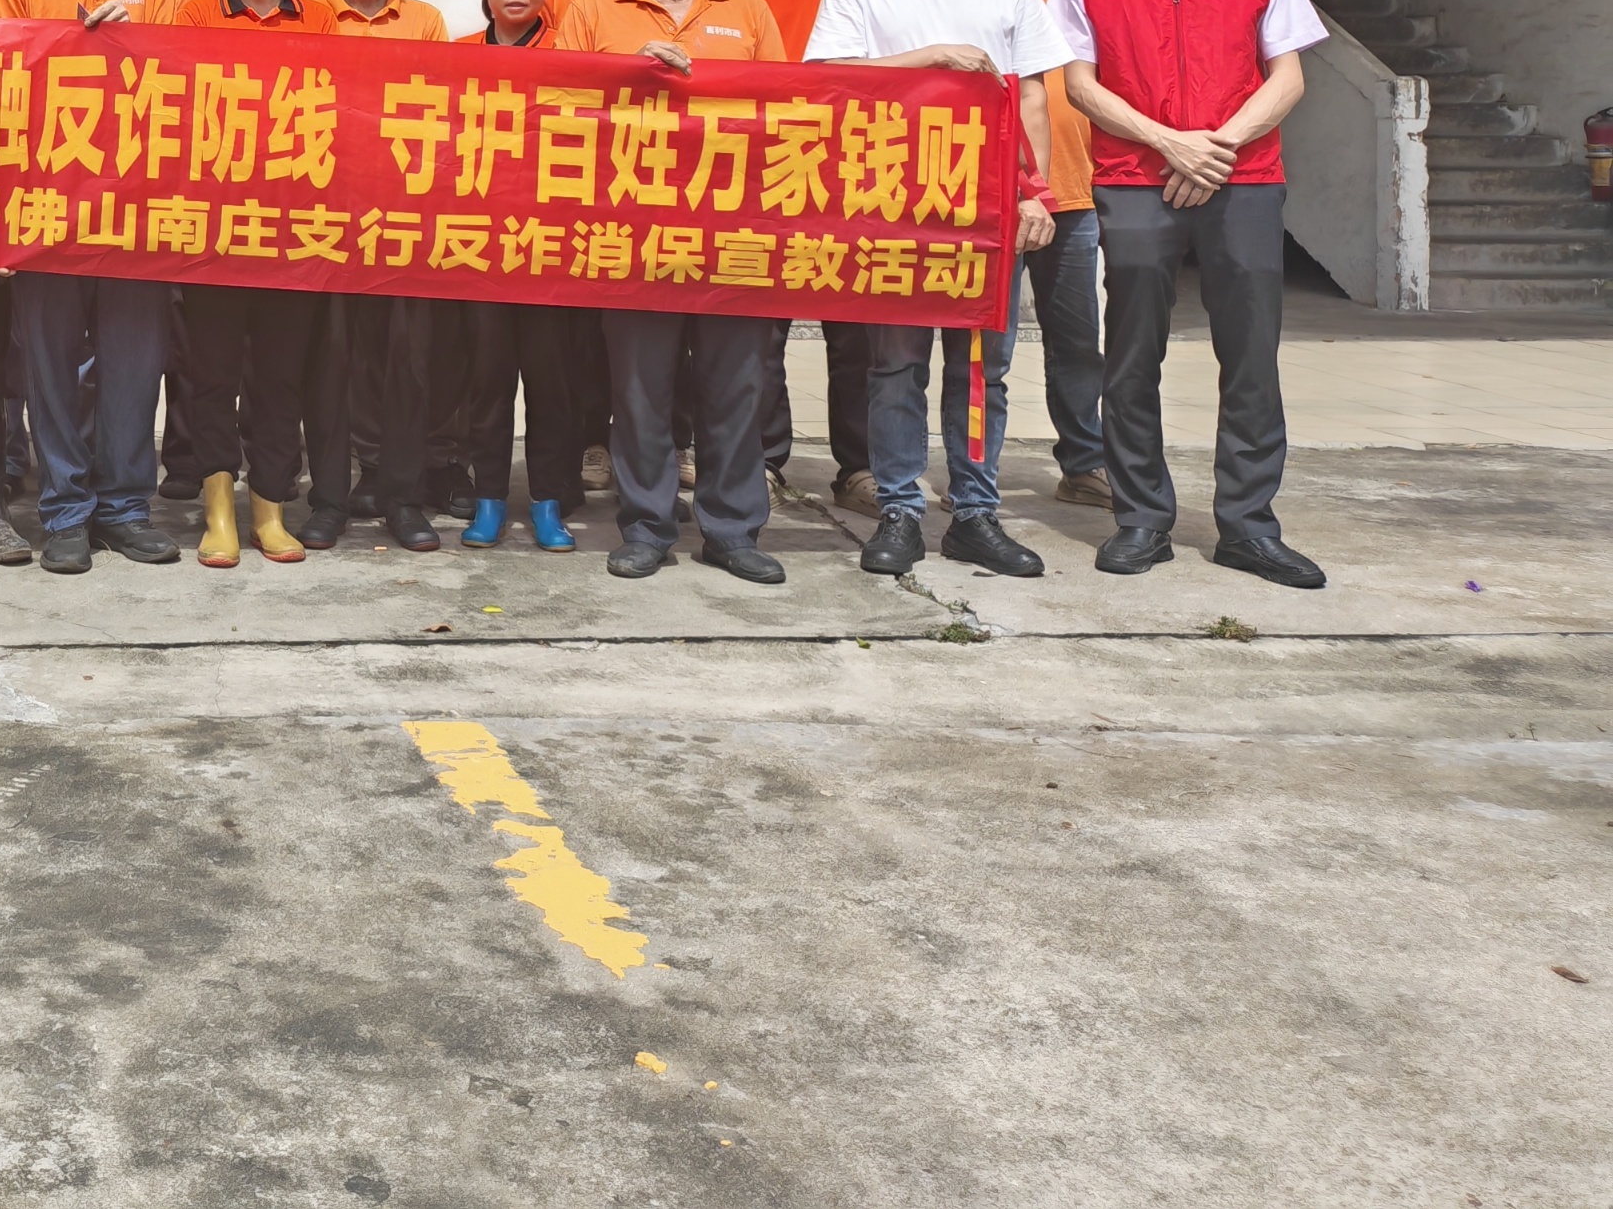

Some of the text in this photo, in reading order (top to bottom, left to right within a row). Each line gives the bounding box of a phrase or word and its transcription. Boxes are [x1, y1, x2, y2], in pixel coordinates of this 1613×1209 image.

[380, 75, 985, 227] 守护百姓万家钱财
